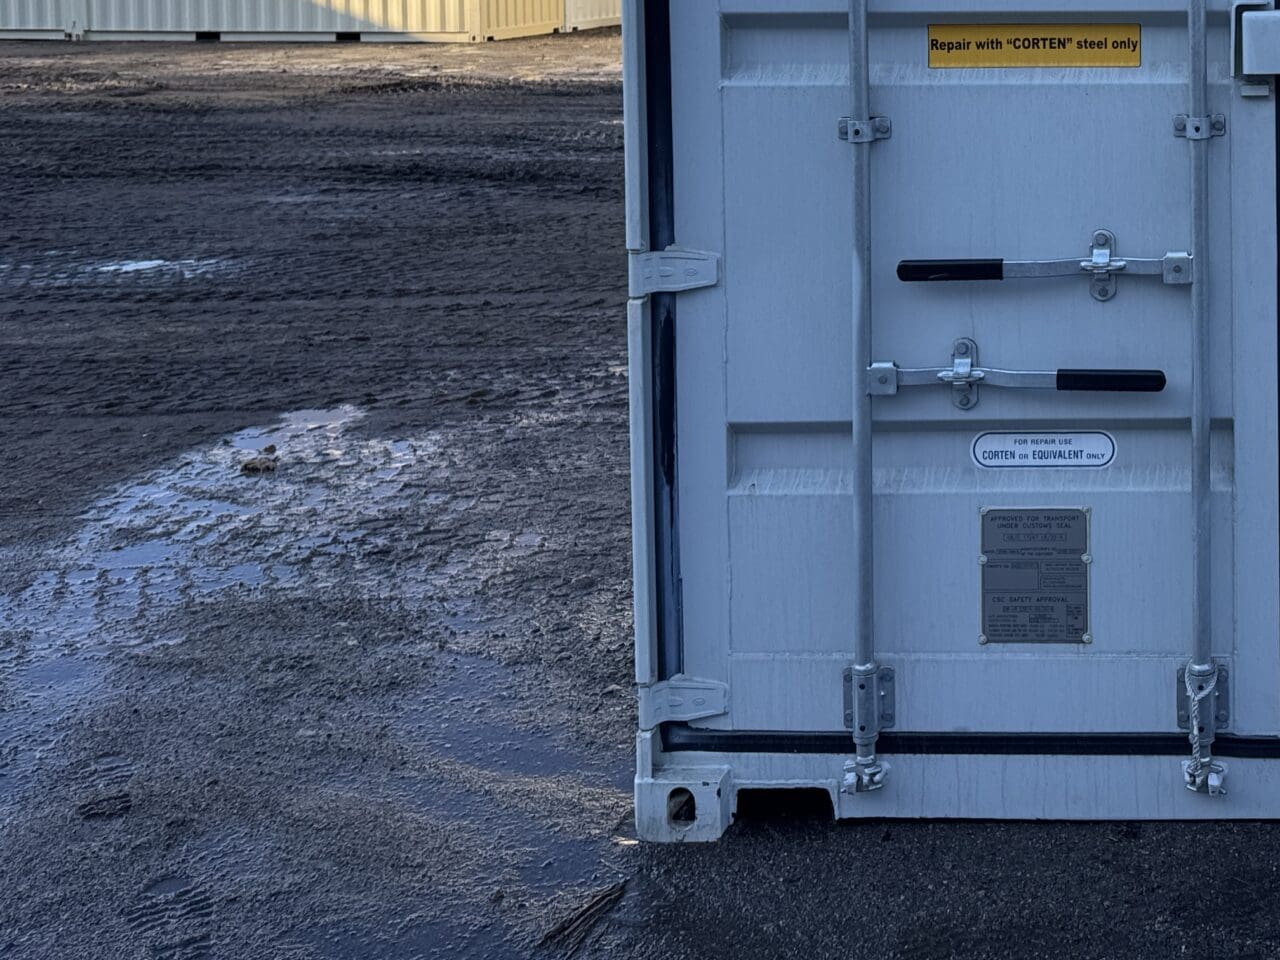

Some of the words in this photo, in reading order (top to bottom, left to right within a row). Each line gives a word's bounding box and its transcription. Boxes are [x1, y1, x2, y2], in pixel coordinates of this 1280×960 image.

[931, 39, 970, 52] Repair
[976, 38, 1002, 50] with
[1077, 38, 1107, 49] steel
[1112, 38, 1138, 52] only
[983, 450, 1015, 460] CORTEN
[1033, 450, 1084, 459] EQUIVALENT
